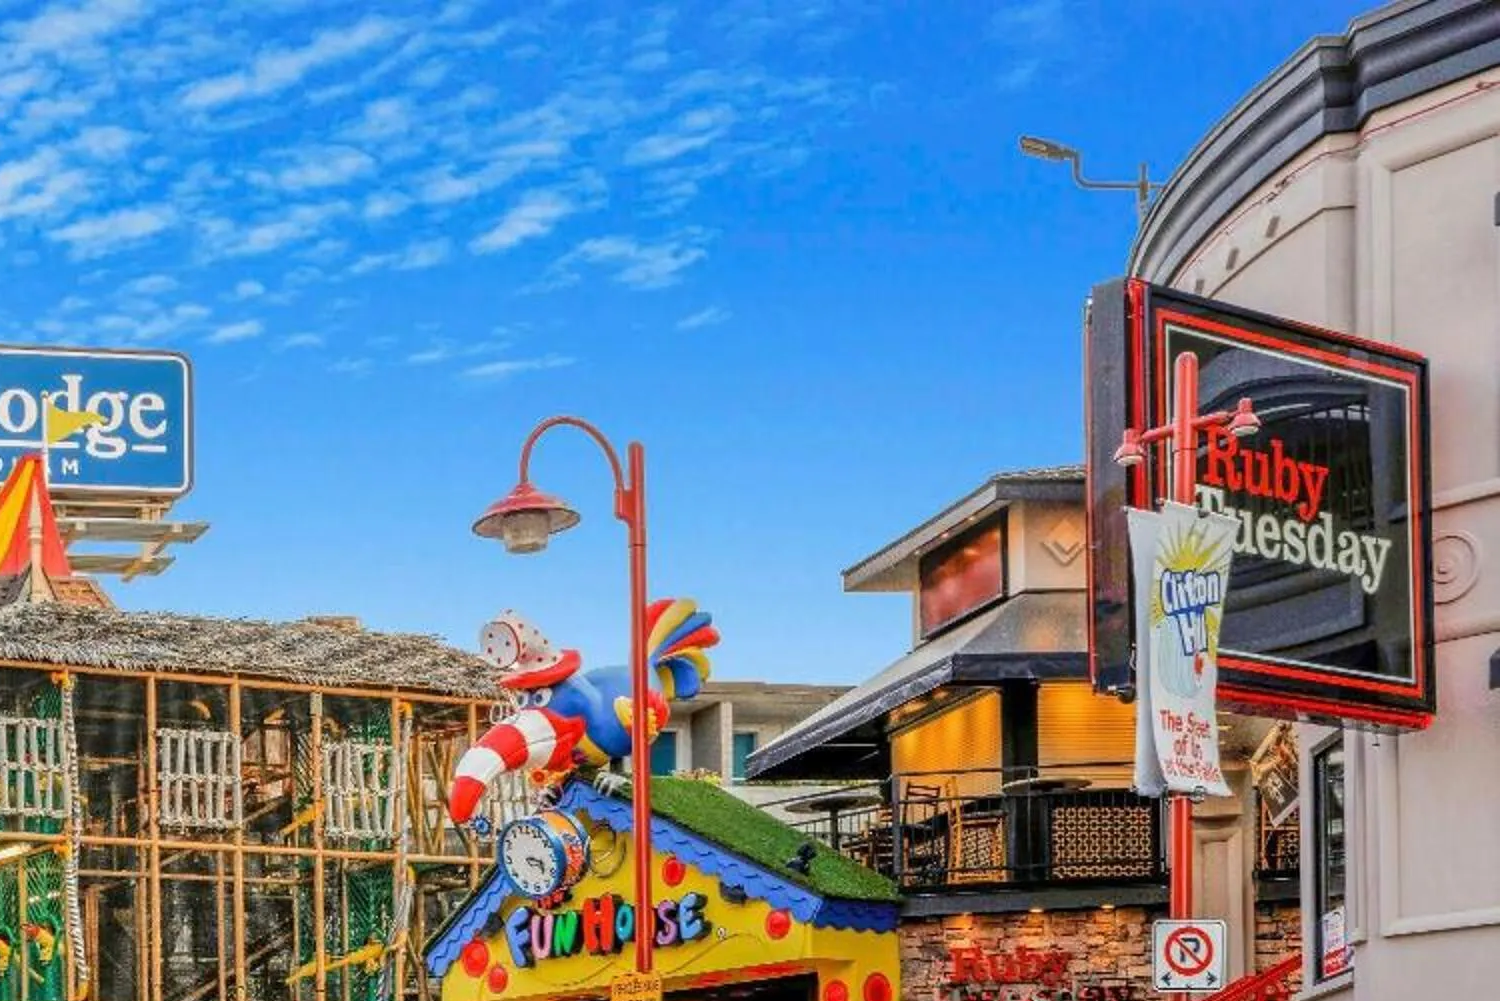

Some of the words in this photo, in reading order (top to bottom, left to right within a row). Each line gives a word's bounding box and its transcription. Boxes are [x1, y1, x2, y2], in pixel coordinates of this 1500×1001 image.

[1202, 422, 1330, 522] Ruby
[1160, 567, 1221, 617] Clifton
[1159, 709, 1183, 733] The
[505, 905, 578, 968] FUN
[583, 891, 706, 954] HOSE
[948, 946, 1071, 987] Ruby
